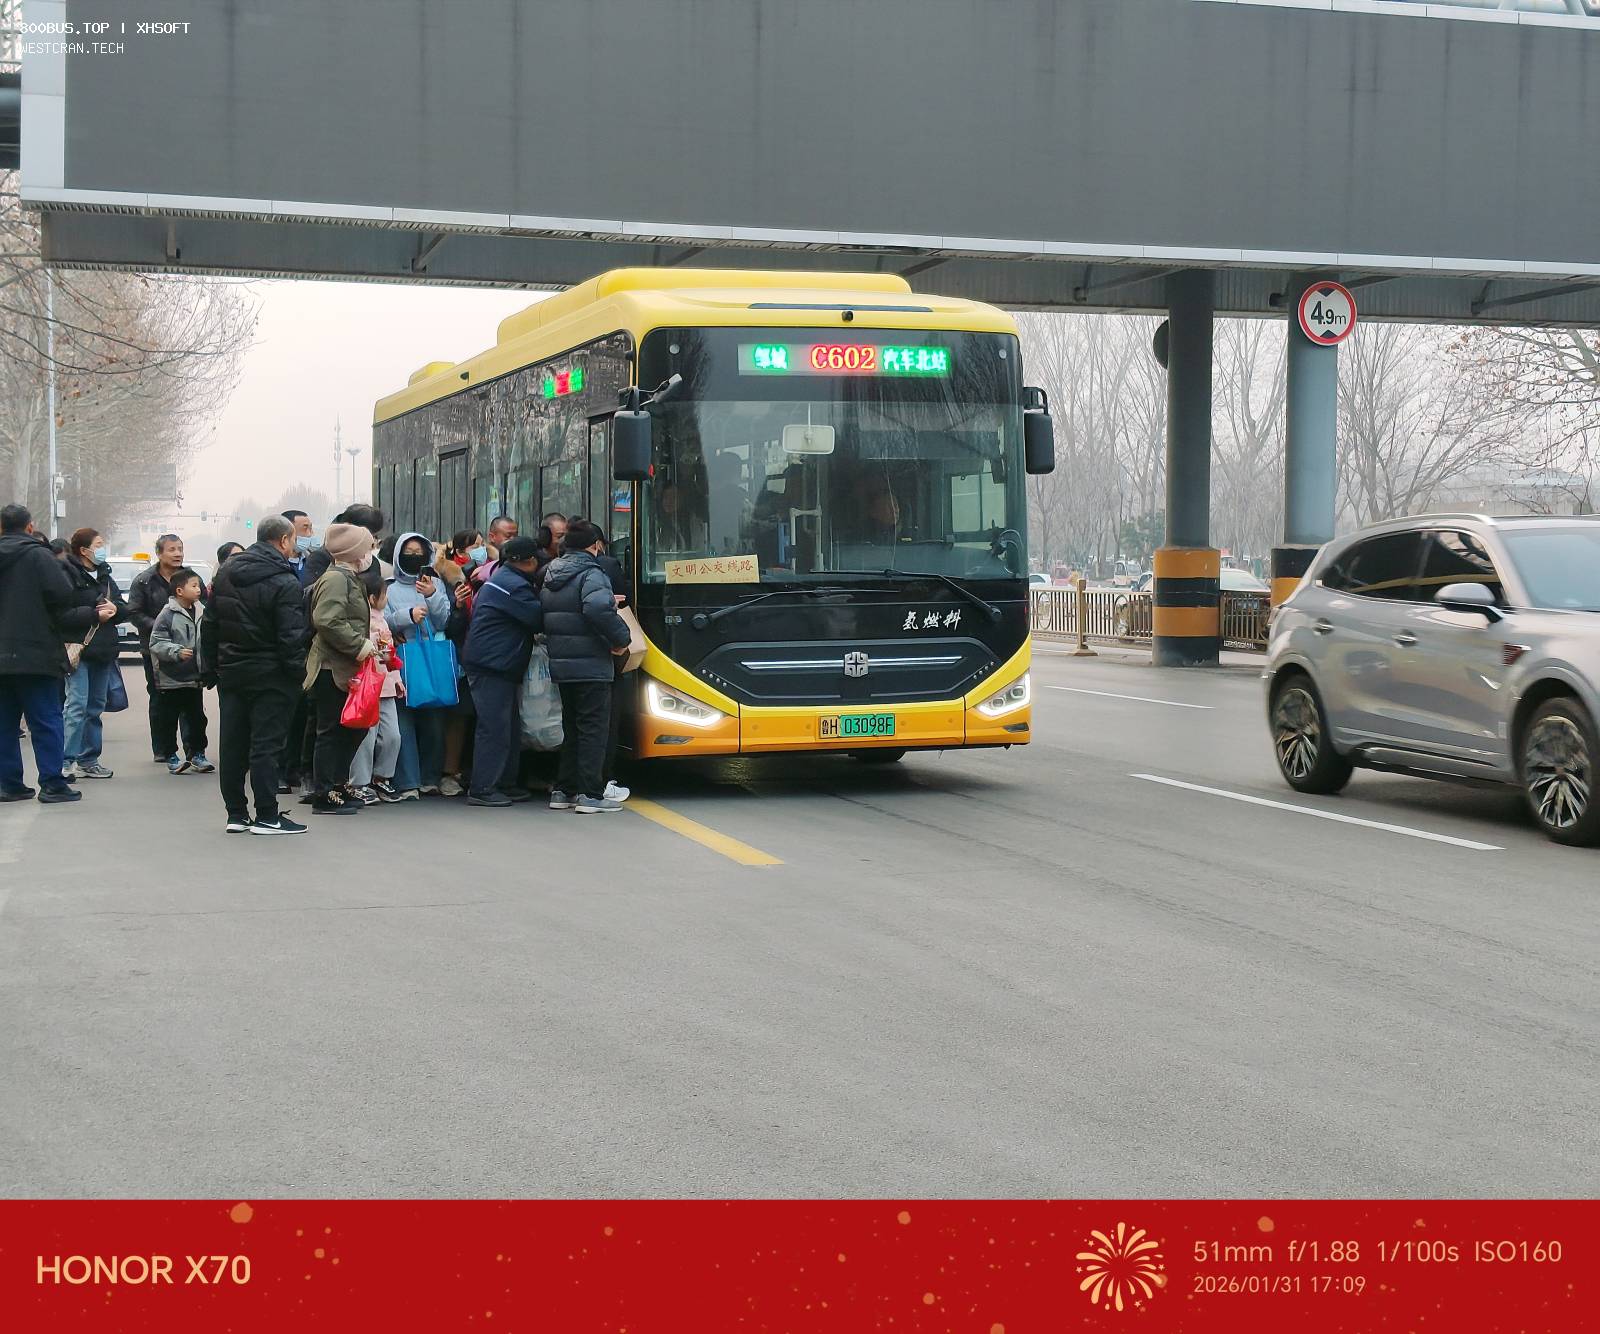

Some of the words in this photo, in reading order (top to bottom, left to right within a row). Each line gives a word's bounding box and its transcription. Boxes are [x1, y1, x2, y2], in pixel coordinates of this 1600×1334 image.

[1310, 300, 1347, 325] 4.9m
[811, 346, 875, 369] C602
[883, 348, 947, 371] 汽车北站
[672, 560, 754, 577] 文明公交线路
[902, 608, 962, 631] 氢燃料
[844, 716, 894, 734] 03098F
